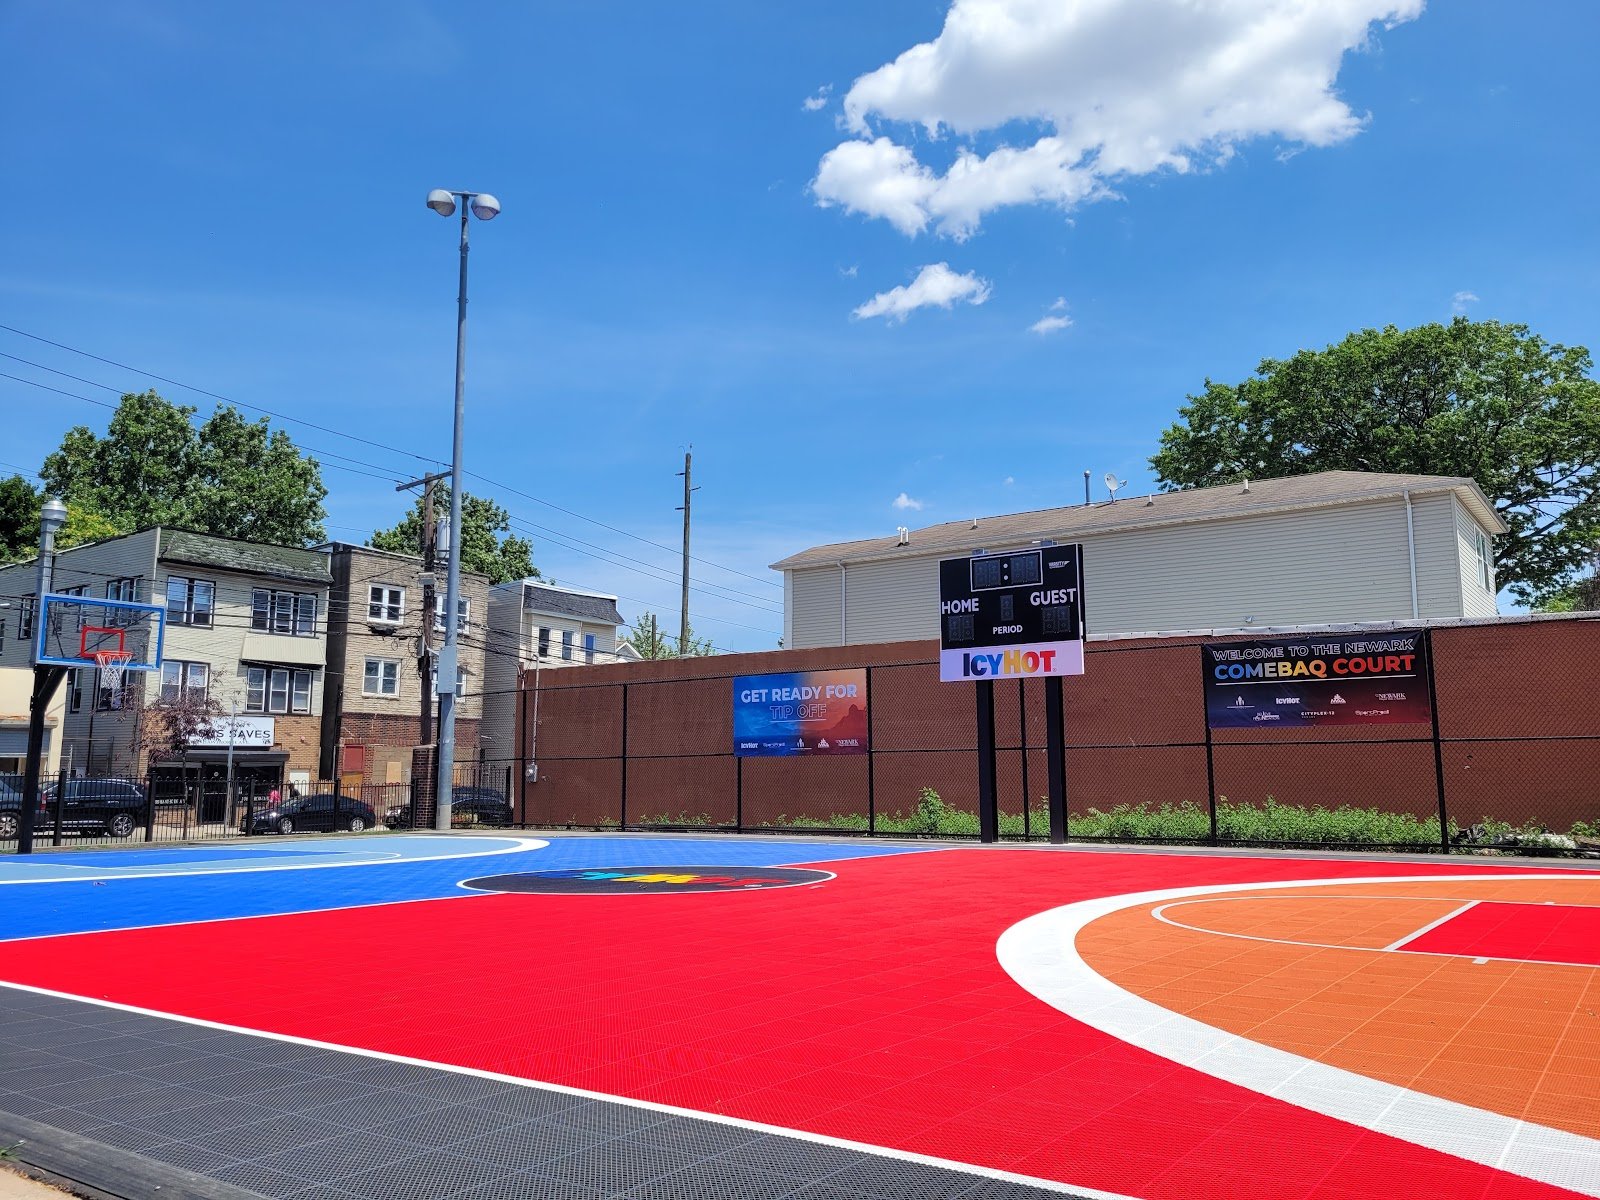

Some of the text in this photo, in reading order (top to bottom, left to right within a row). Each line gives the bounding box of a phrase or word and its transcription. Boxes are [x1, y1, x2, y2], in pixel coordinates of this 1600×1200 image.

[1030, 588, 1076, 606] GUEST
[941, 598, 979, 615] HOME
[992, 625, 1023, 635] PERIOD
[1212, 639, 1414, 661] WELCOME TO THE NEWARK
[963, 650, 1056, 677] ICYHOT
[1214, 655, 1415, 680] COMEBAQ COURT
[741, 684, 858, 704] GET READY FOR
[770, 703, 827, 720] TIP OFF
[229, 729, 271, 739] SAVES
